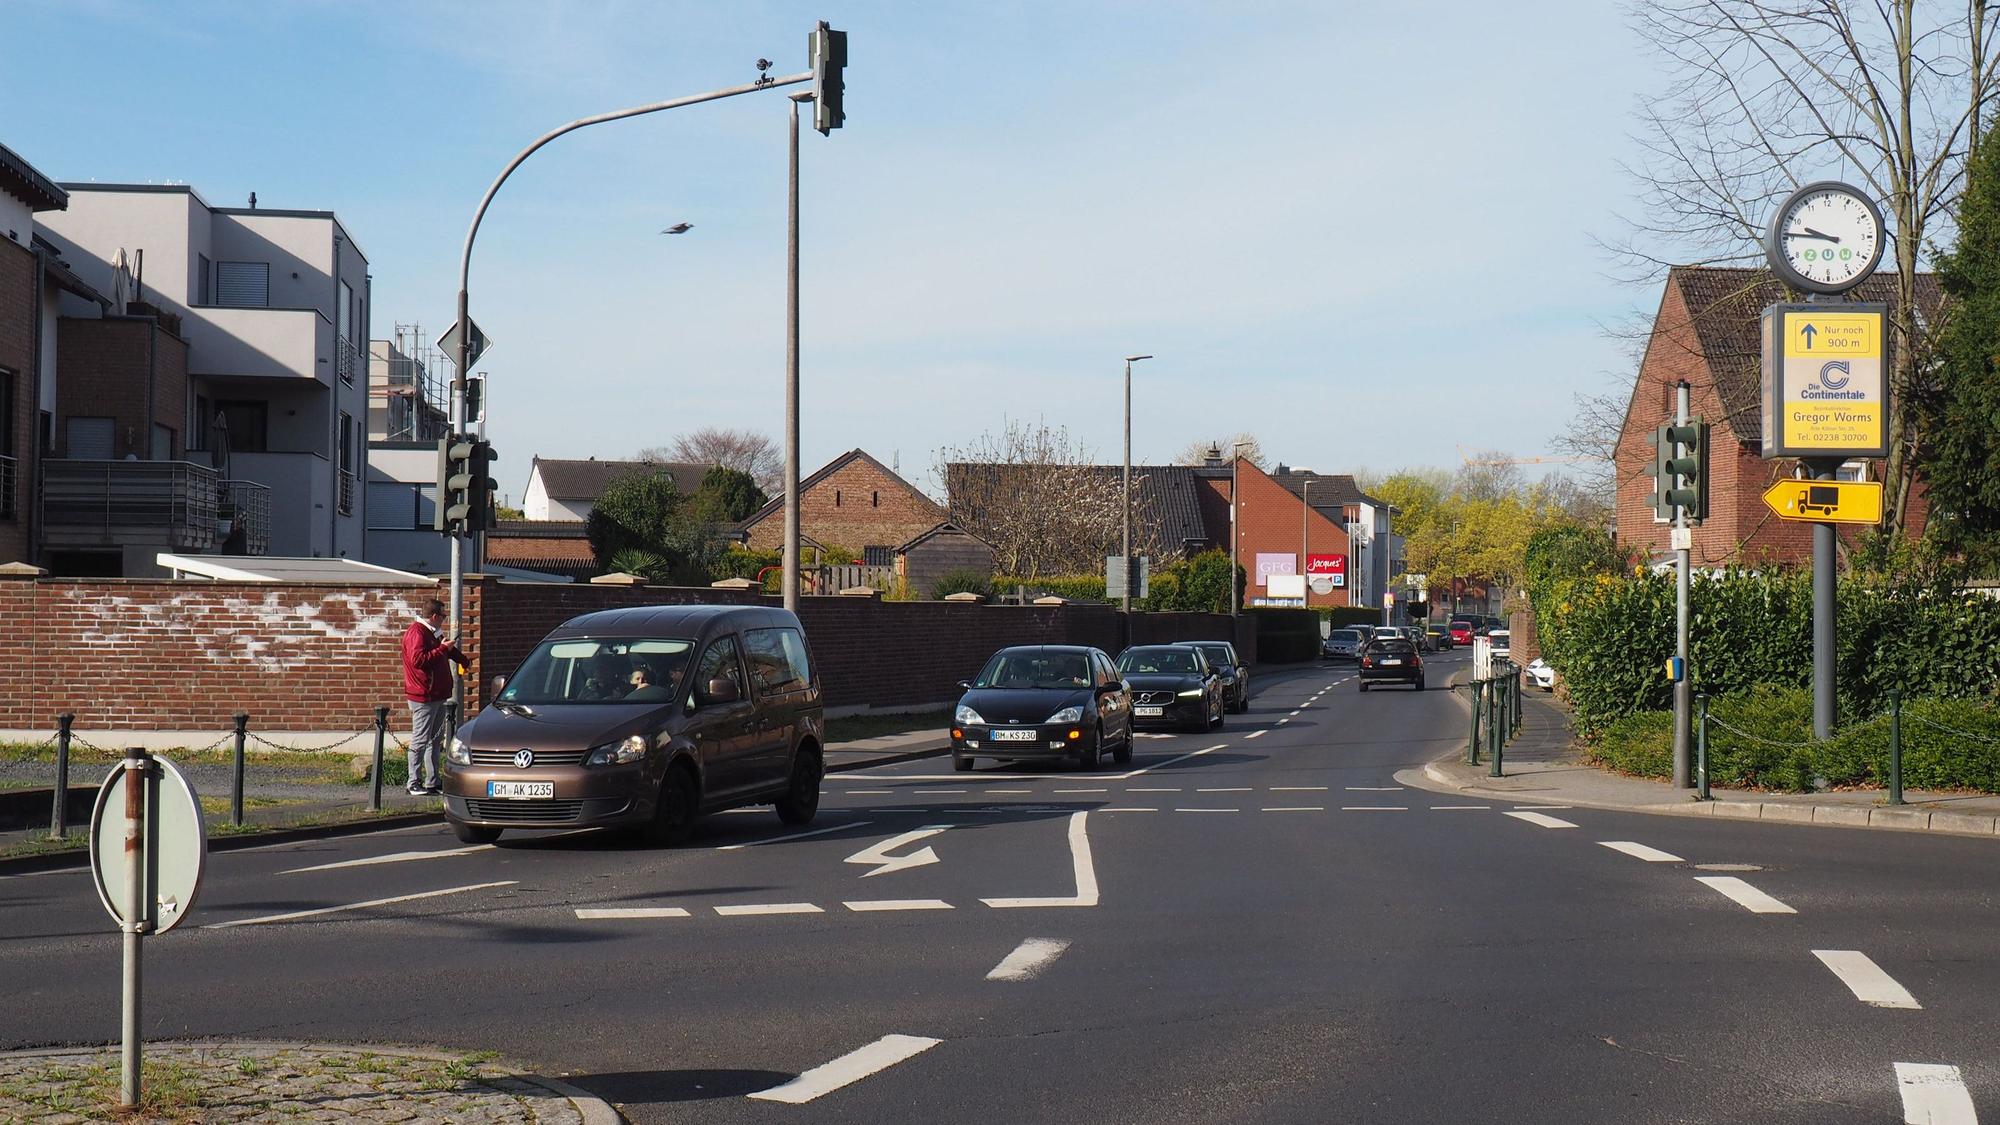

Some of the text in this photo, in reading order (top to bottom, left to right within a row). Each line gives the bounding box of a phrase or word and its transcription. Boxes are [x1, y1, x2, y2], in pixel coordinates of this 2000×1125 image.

[1824, 326, 1864, 334] Nur noch
[1828, 339, 1848, 347] 900
[1808, 383, 1821, 391] Die
[1801, 390, 1865, 400] Continentale
[1793, 412, 1872, 425] Gregor Worms
[1797, 433, 1868, 441] Tel. 02238 30700
[1260, 561, 1291, 573] GFG
[995, 732, 1005, 740] BM
[1021, 732, 1036, 740] 230
[494, 784, 552, 796] GM AK 1235
